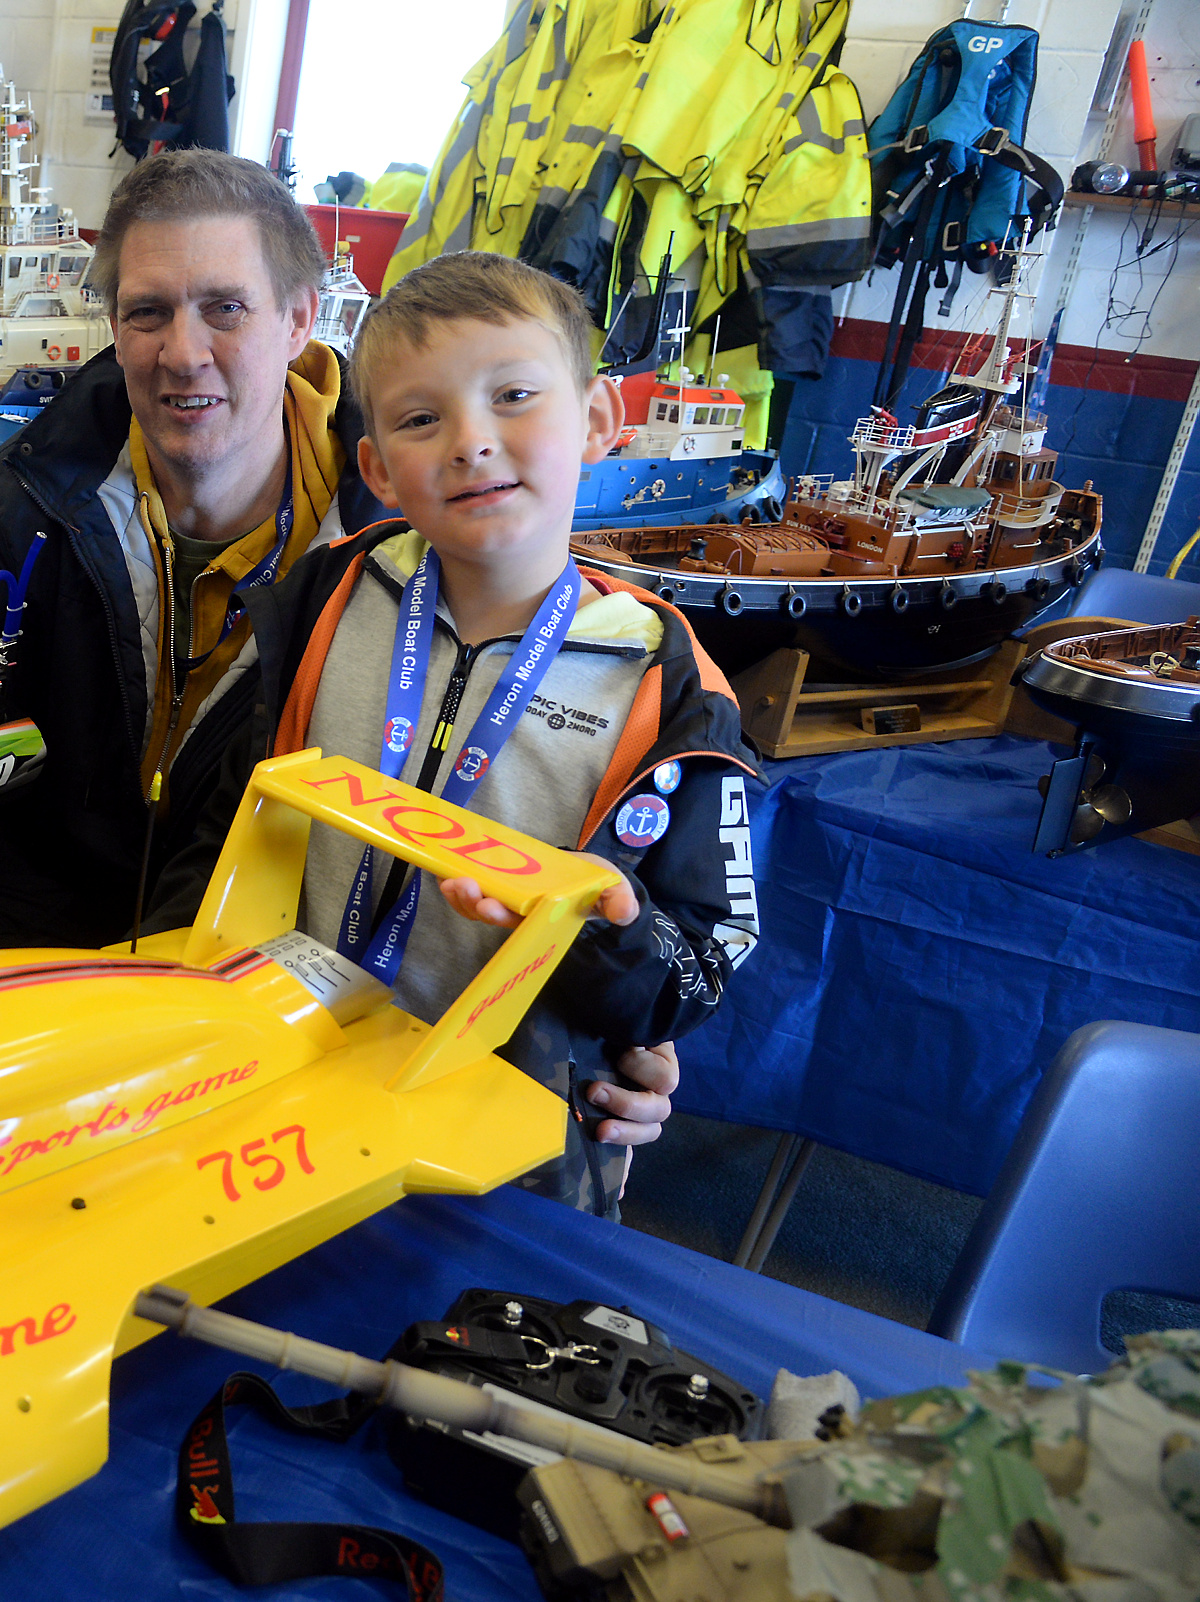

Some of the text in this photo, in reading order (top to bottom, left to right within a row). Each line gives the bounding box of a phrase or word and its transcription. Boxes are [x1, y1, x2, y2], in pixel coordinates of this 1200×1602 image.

[968, 36, 1003, 53] GP
[856, 540, 884, 554] LONDON
[409, 576, 427, 616] Model
[404, 620, 421, 652] Boat
[490, 583, 573, 726] Heron Model Boat Club
[399, 656, 416, 690] Club
[525, 705, 597, 737] ODAY 2MORO
[530, 694, 609, 729] PIC VIBES
[299, 771, 542, 876] NQD
[618, 808, 630, 832] MODEL
[657, 813, 667, 834] BOAT
[353, 871, 368, 905] Boat
[347, 909, 360, 944] Club
[374, 924, 400, 968] Heron
[456, 943, 557, 1040] game
[131, 1060, 260, 1133] game
[196, 1124, 316, 1203] 757
